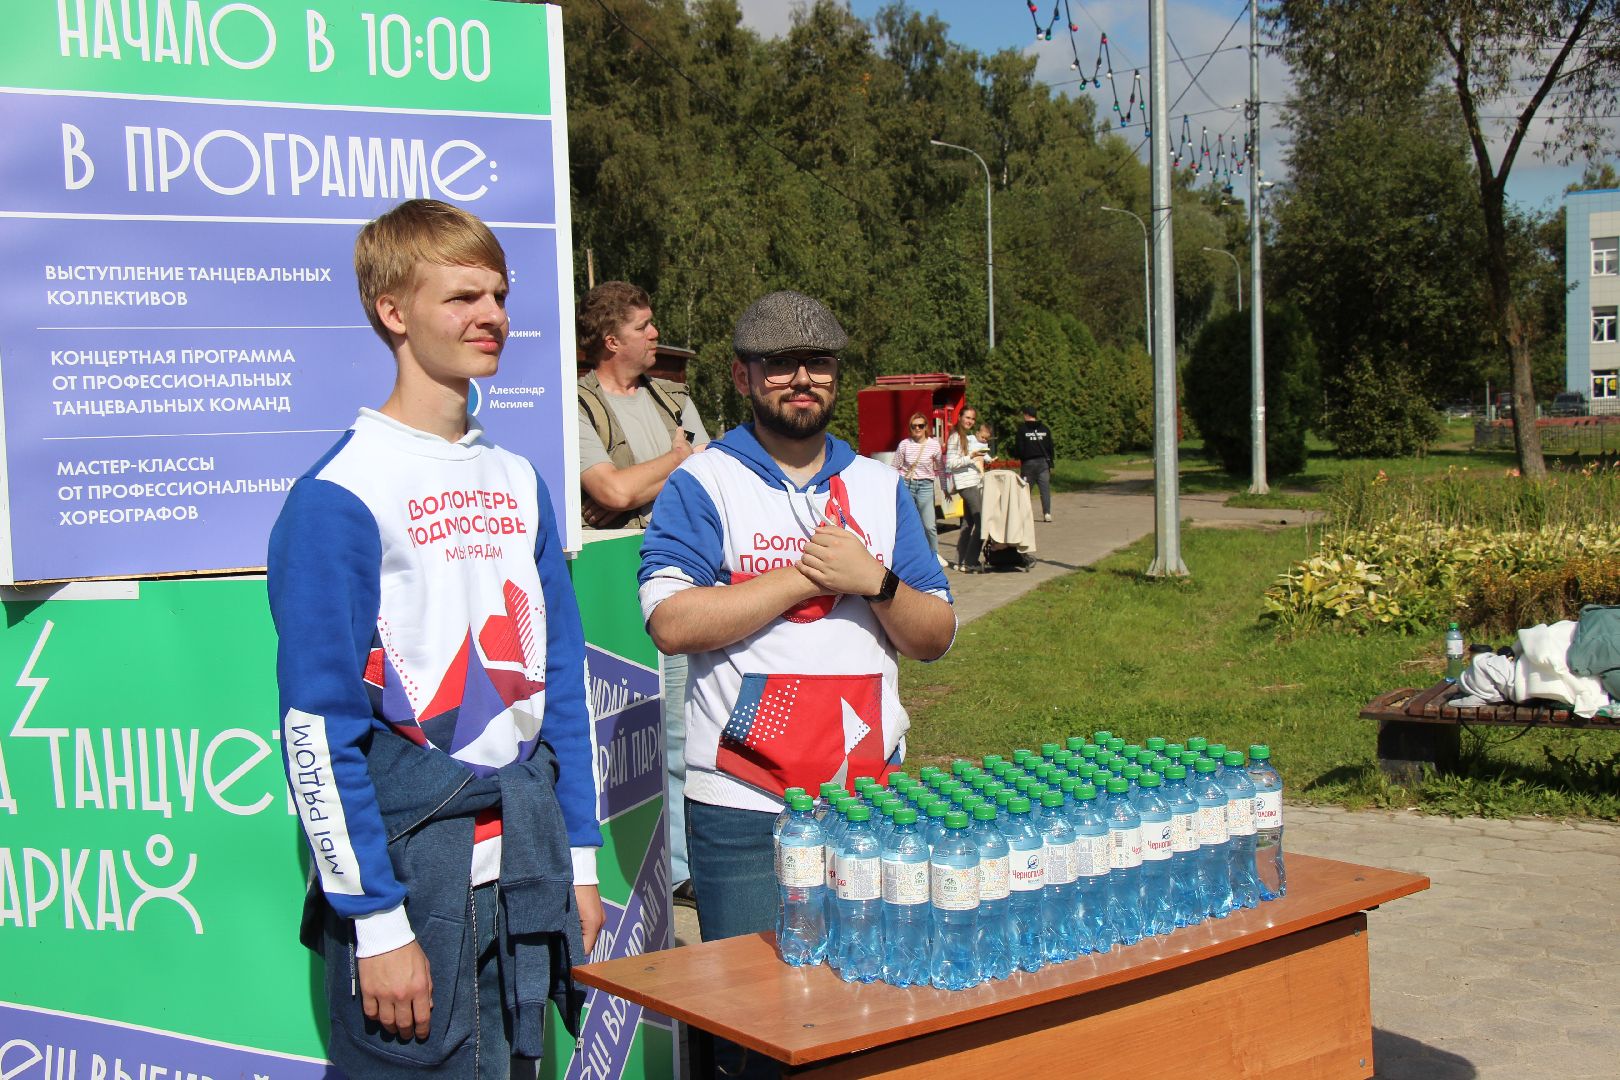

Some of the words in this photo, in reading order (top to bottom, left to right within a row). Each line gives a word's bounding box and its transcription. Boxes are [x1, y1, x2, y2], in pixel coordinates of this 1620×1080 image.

[57, 0, 277, 70] НАЧАЛО
[306, 9, 335, 73] В
[361, 12, 491, 83] 10:00
[61, 122, 95, 190] В
[45, 265, 184, 281] ВЫСТУПЛЕНИЕ
[187, 266, 332, 284] ТАНЦЕВАЛЬНЫХ
[47, 290, 188, 306] КОЛЛЕКТИВОВ
[51, 349, 176, 368] КОНЦЕРТНАЯ
[181, 349, 296, 364] ПРОГРАММА
[52, 375, 78, 391] ОТ
[82, 372, 292, 390] ПРОФЕССИОНАЛЬНЫХ
[488, 384, 545, 396] Александр
[52, 398, 206, 417] ТАНЦЕВАЛЬНЫХ
[209, 396, 291, 413] КОМАНД
[489, 399, 534, 409] Могилев
[57, 456, 215, 476] МАСТЕР-КЛАССЫ
[58, 485, 83, 501] ОТ
[88, 477, 297, 500] ПРОФЕССИОНАЛЬНЫХ
[59, 505, 199, 526] ХОРЕОГРАФОВ
[10, 727, 298, 818] ТАНЦУЕ
[291, 724, 329, 822] РЯДОМ
[313, 830, 344, 875] МЫ
